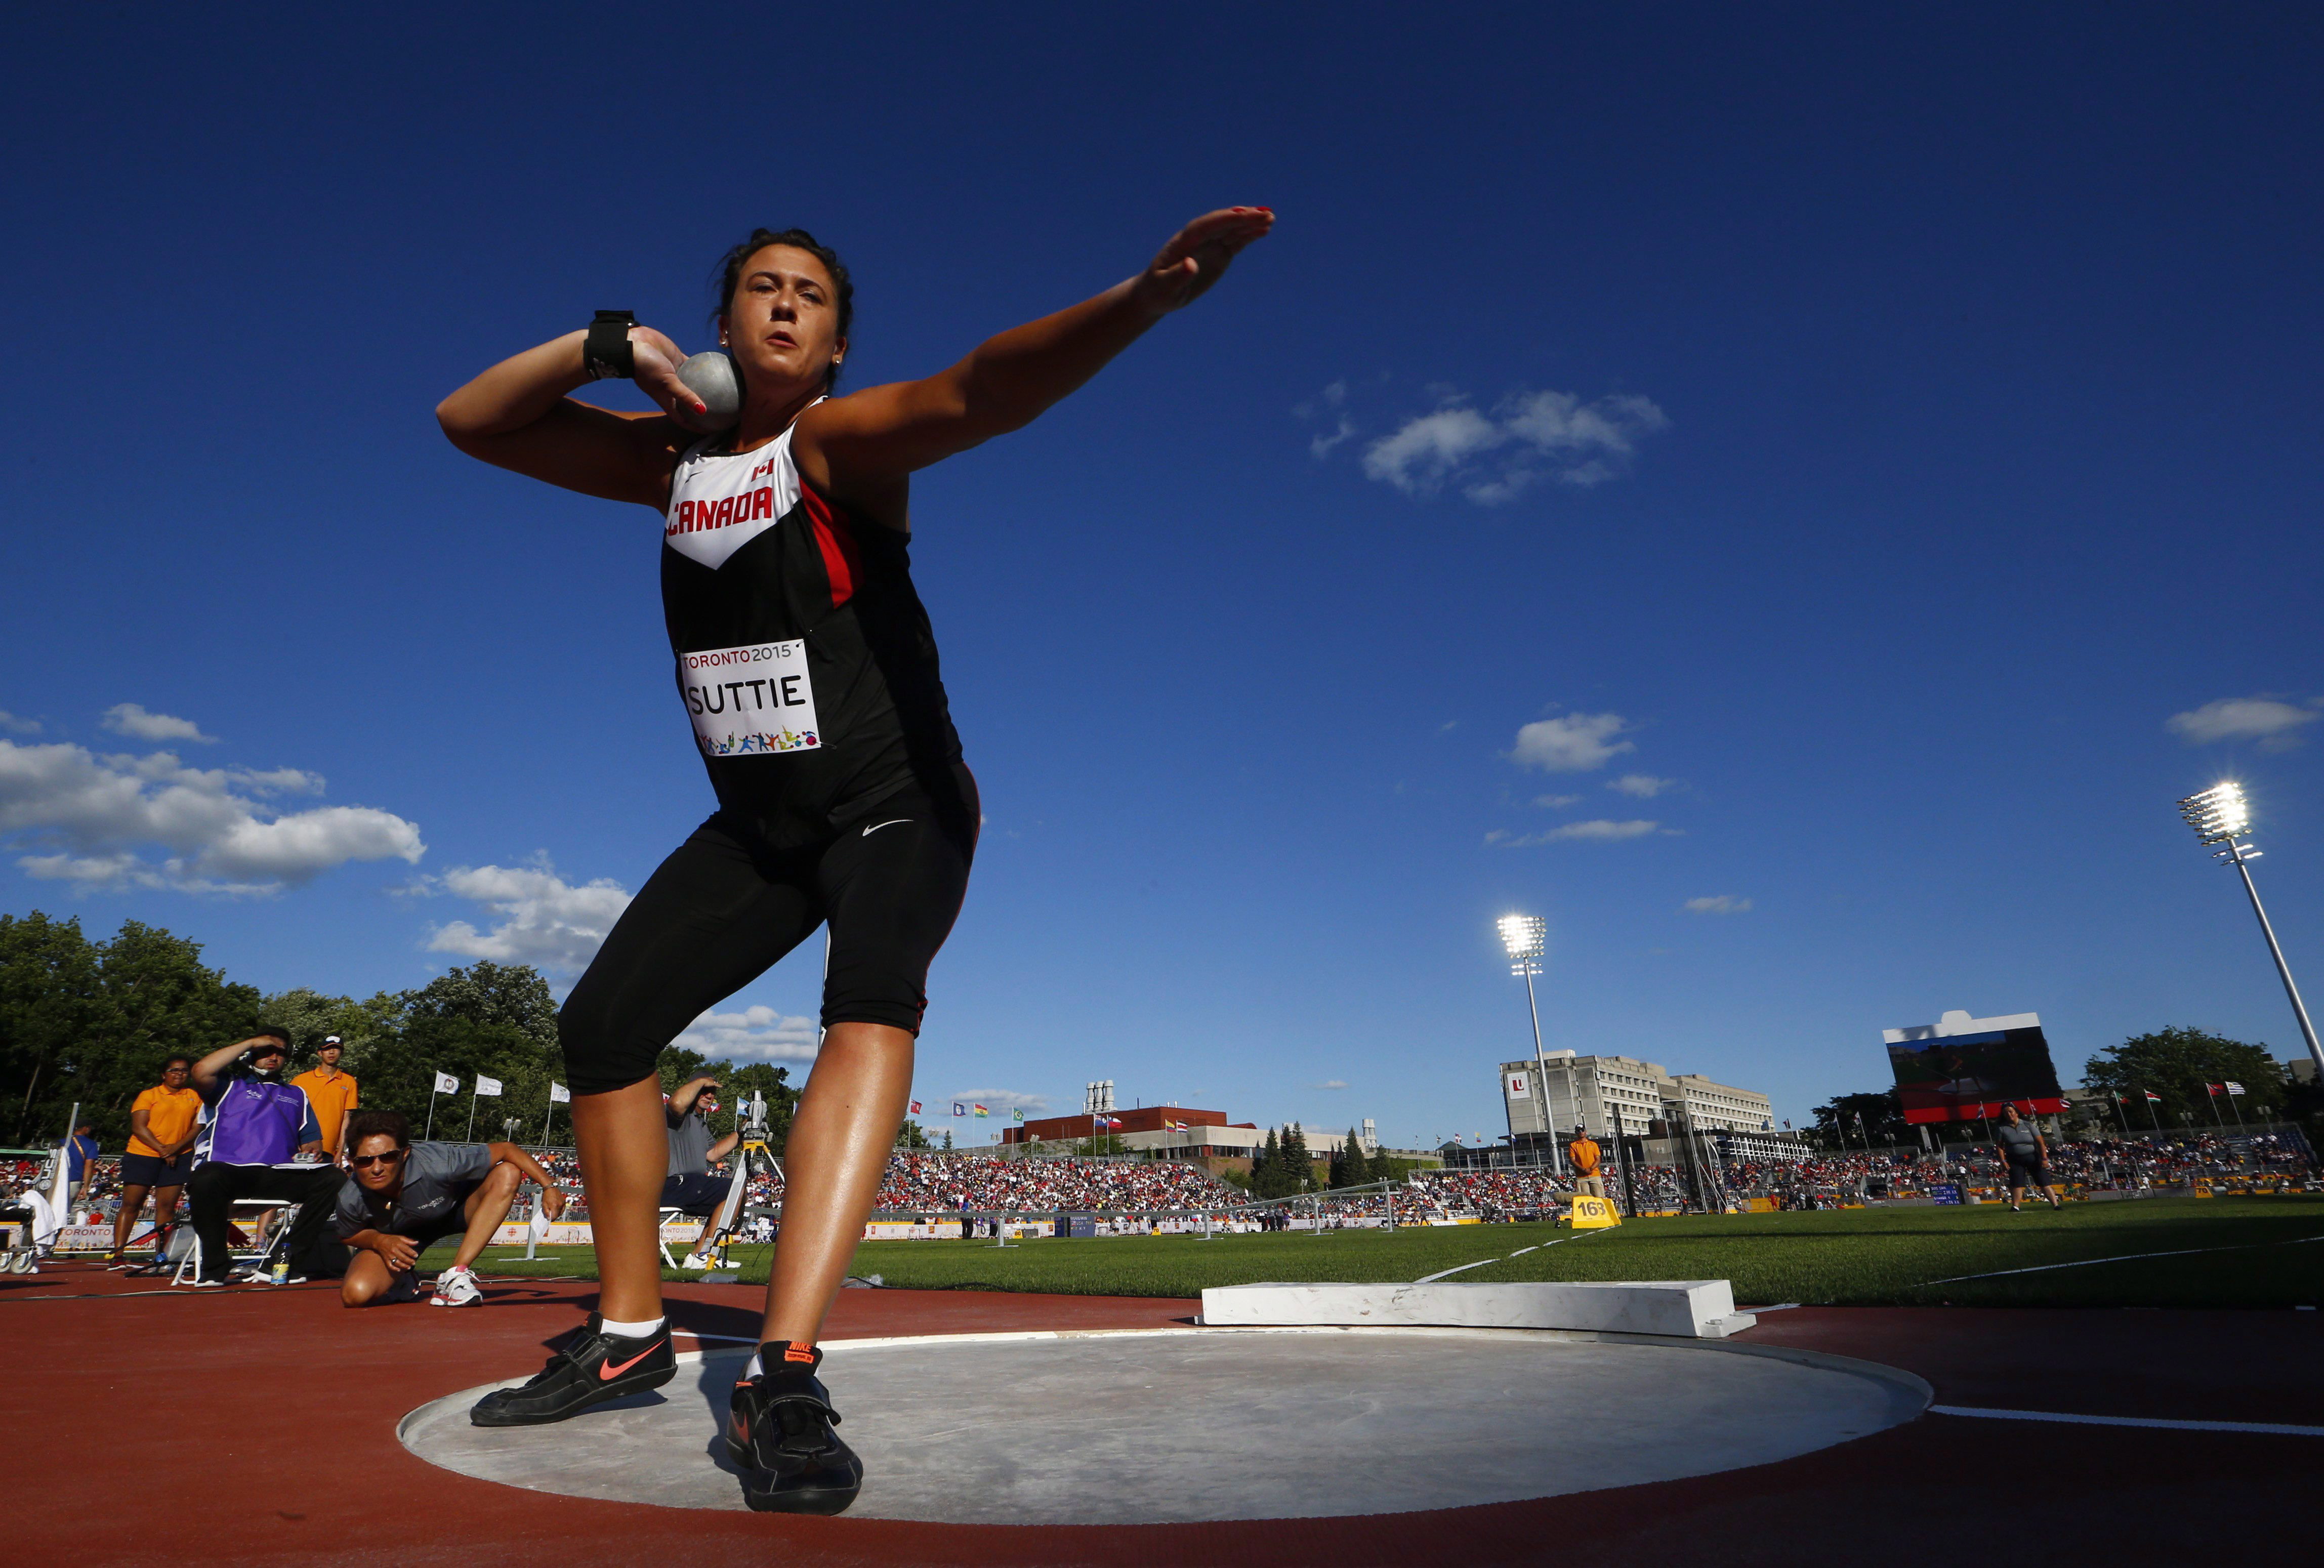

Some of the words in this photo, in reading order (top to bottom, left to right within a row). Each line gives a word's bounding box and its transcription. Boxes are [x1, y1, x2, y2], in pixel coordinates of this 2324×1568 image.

[668, 486, 772, 537] CANADA
[688, 675, 806, 715] SUTTIE
[789, 1341, 812, 1352] NIKE
